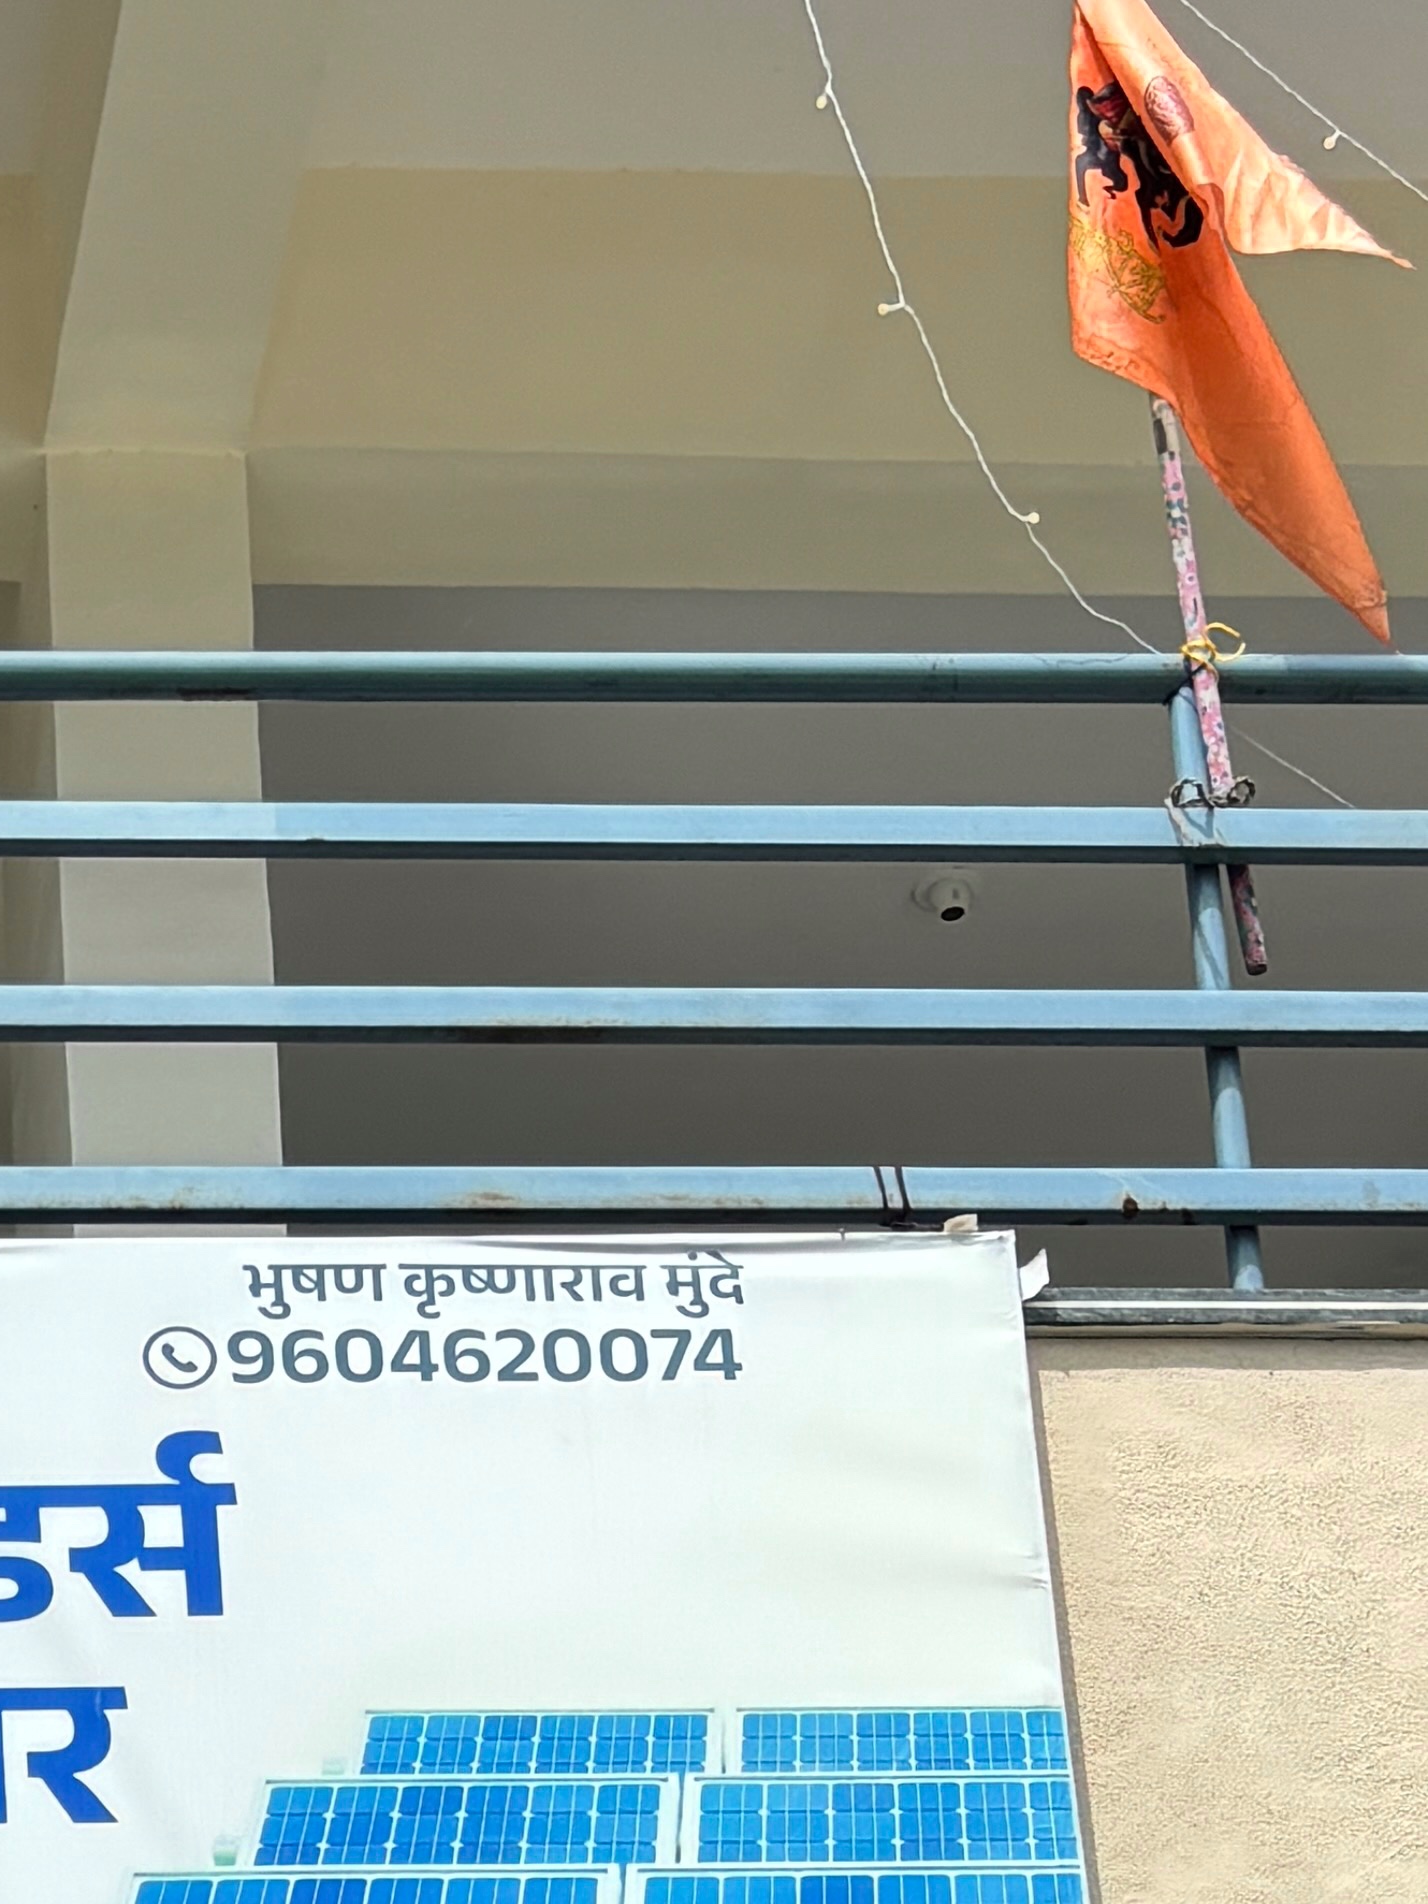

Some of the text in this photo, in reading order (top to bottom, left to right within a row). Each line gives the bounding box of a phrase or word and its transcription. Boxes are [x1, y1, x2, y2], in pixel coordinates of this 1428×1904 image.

[242, 1263, 387, 1320] भुषण
[398, 1263, 647, 1320] कृष्णाराव
[227, 1327, 743, 1385] 9604620074
